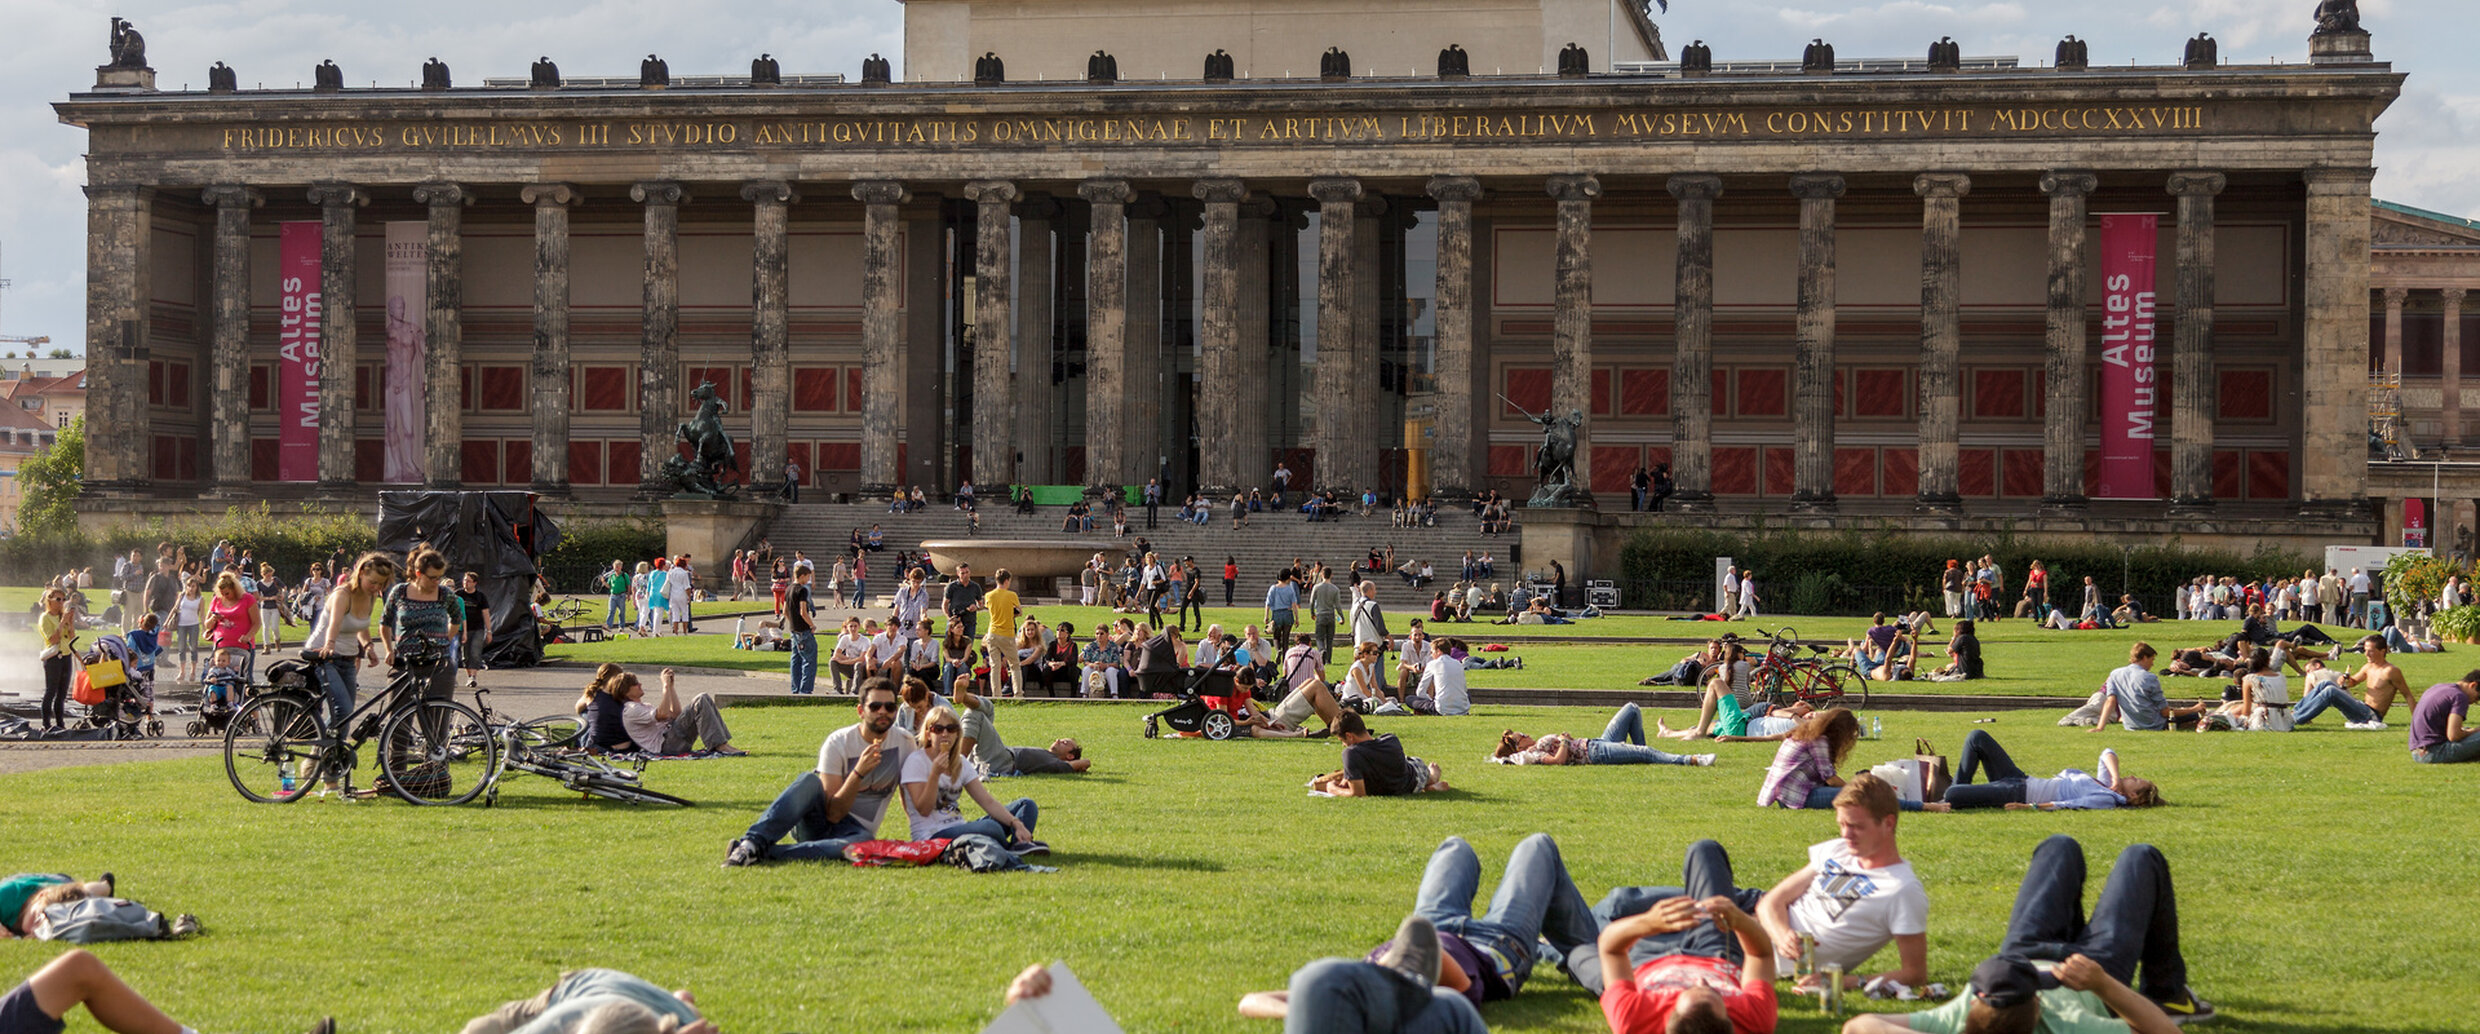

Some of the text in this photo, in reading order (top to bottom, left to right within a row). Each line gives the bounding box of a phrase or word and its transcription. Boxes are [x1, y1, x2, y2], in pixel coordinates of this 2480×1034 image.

[223, 107, 2202, 149] FRIDERICVS GVILELMVS III STVDIO ANTIQVITATIS OMNIGENAE ET ARTIVM LIBERALIVM MVSEVM CONSTITVIT MDCCCXXVIII
[280, 277, 302, 363] Altes
[2101, 273, 2130, 368] Altes
[2127, 291, 2156, 439] Museum
